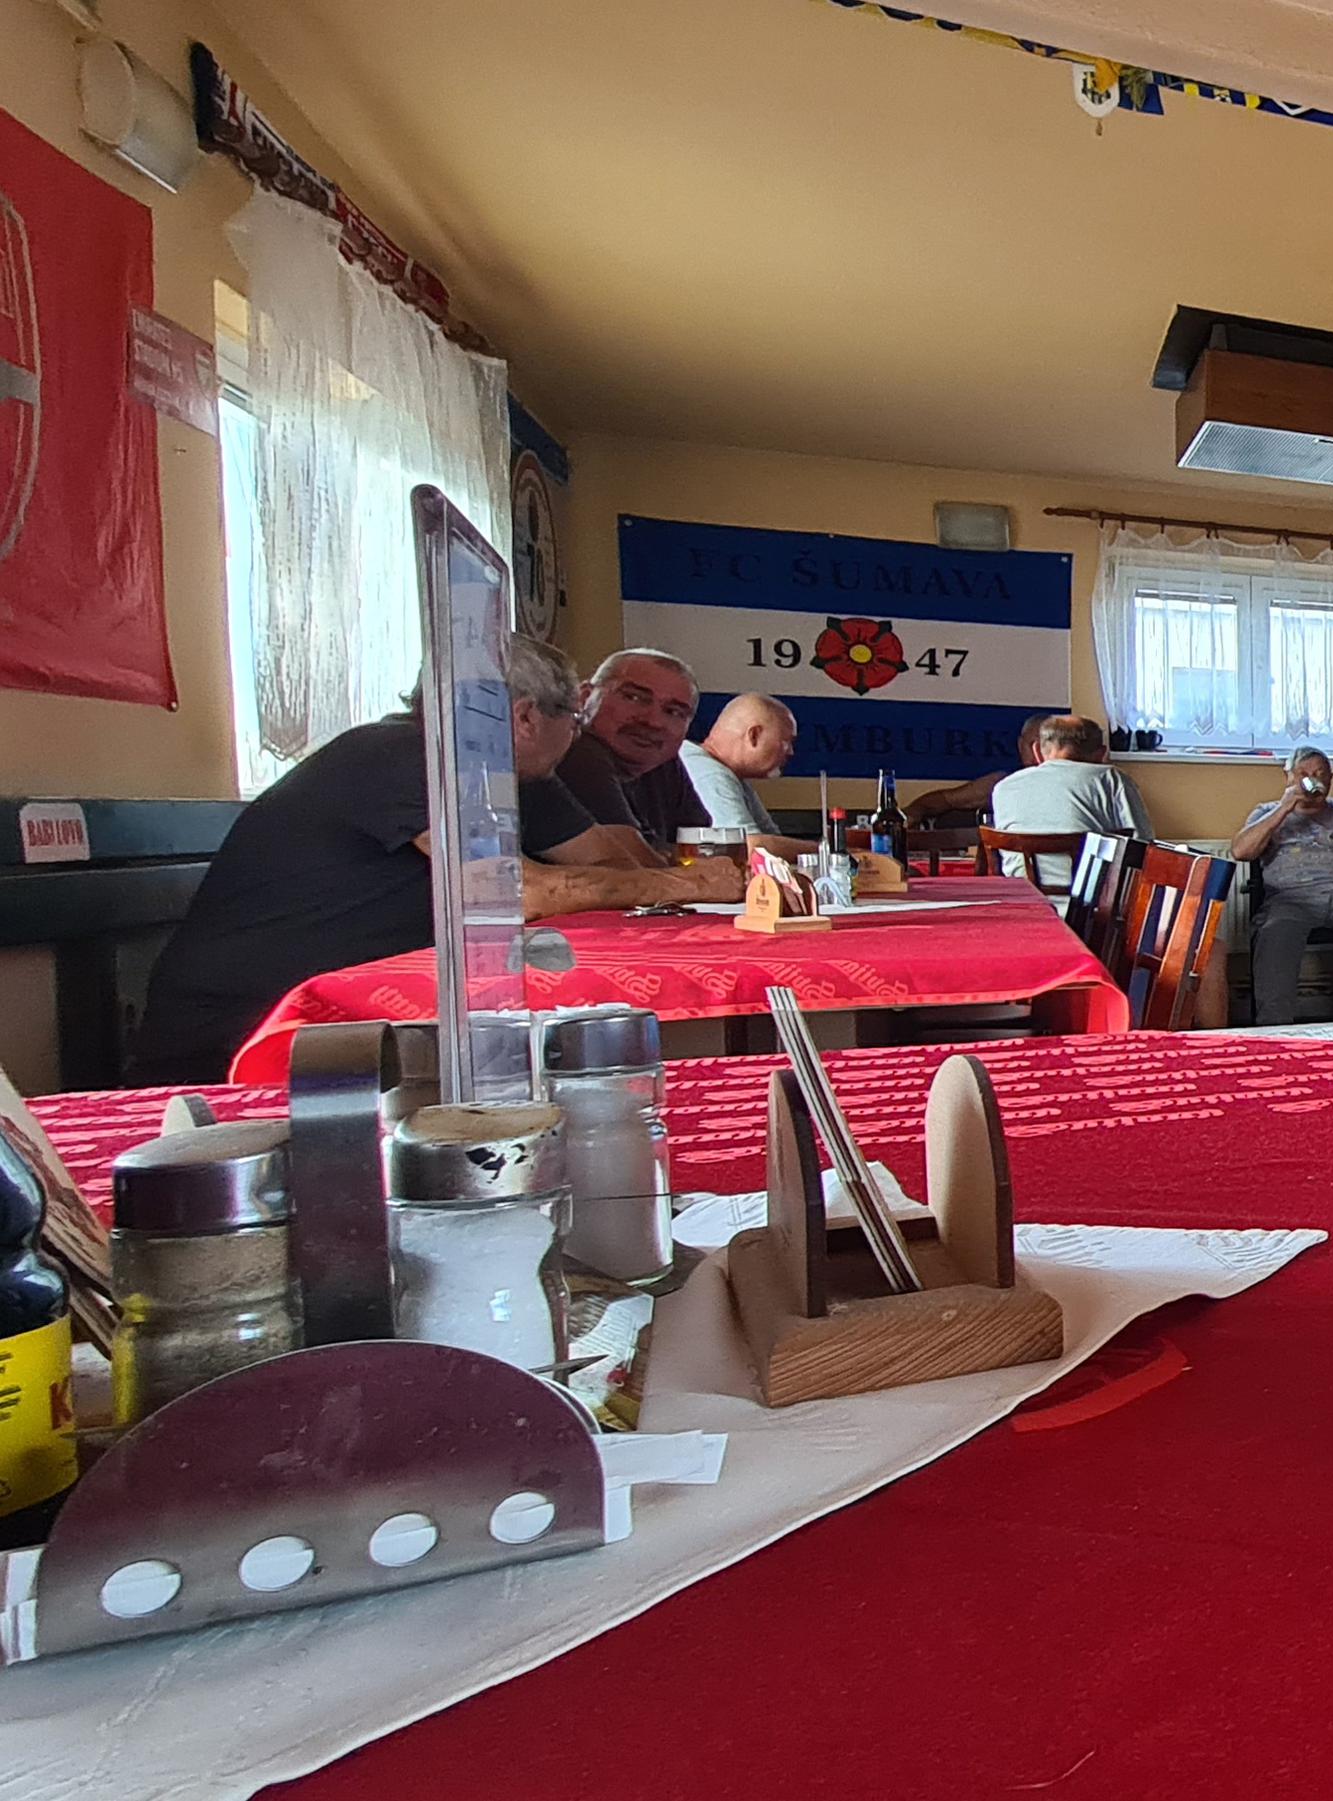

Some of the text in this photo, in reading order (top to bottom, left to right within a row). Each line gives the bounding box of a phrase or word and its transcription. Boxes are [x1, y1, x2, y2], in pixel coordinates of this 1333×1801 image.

[690, 546, 1011, 600] FC ŠUMAVA
[746, 637, 970, 678] 19 47
